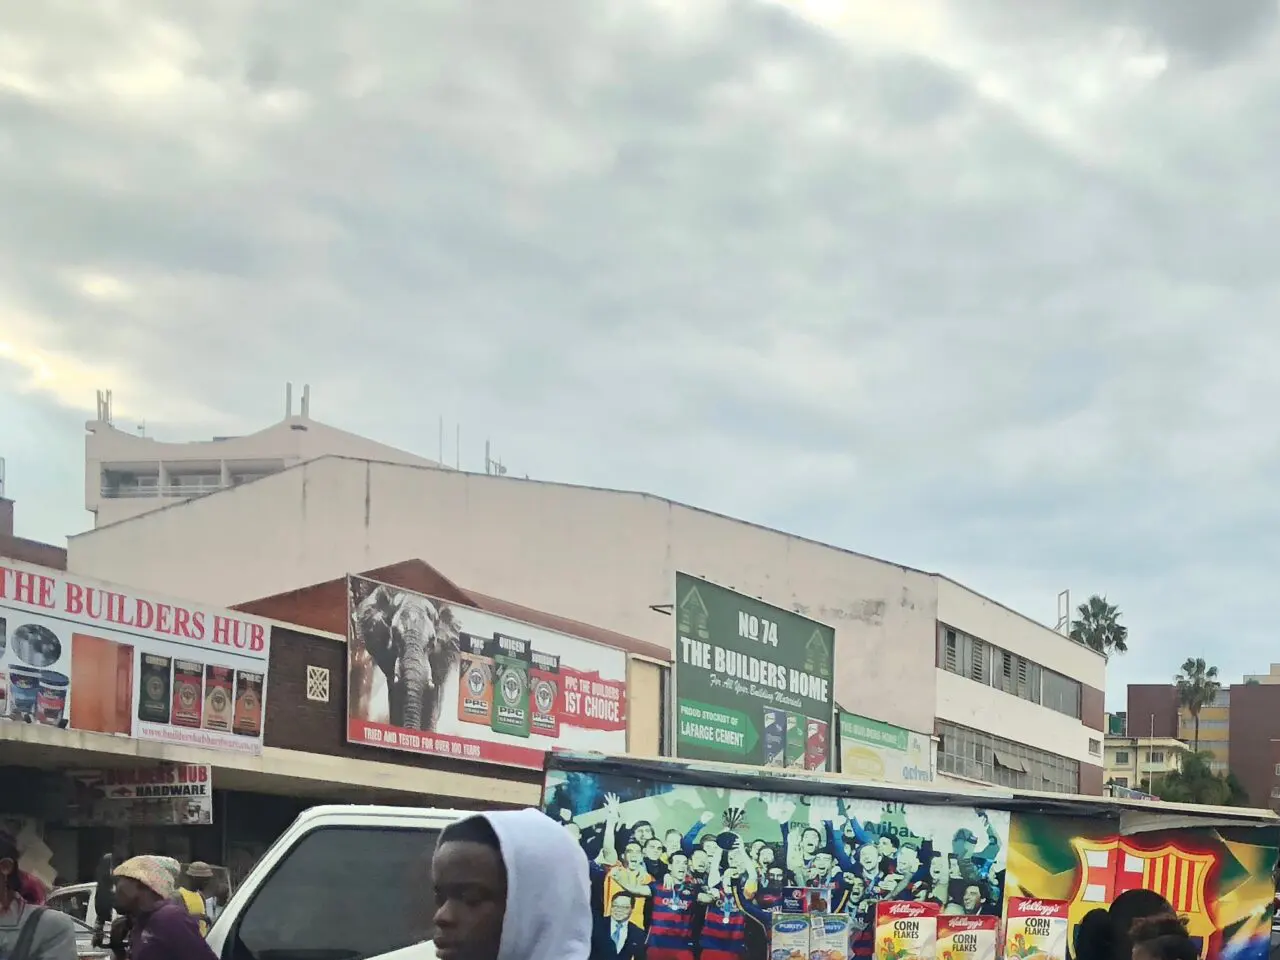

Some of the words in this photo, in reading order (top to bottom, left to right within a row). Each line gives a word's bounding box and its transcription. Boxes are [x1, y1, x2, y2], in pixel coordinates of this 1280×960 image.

[0, 567, 56, 609] THE
[64, 582, 205, 640] BUILDERS
[212, 615, 265, 652] HUB
[761, 619, 778, 648] 74
[680, 636, 711, 670] THE
[714, 646, 787, 691] BUILDERS
[789, 668, 828, 702] HOME
[565, 675, 578, 691] PPC
[580, 679, 590, 691] THE
[465, 698, 487, 708] PPC
[564, 690, 581, 715] 1ST
[585, 695, 620, 722] CHOICE
[500, 706, 523, 717] PPC
[680, 705, 701, 719] PROUD
[384, 730, 397, 743] AND
[399, 732, 420, 748] TESTED
[681, 720, 714, 744] LAFARGE
[715, 727, 745, 747] CEMENT
[178, 765, 207, 783] HUB
[136, 784, 206, 797] HARDWARE
[889, 904, 926, 917] Kellogg's
[1018, 899, 1061, 916] Kellogg's
[894, 920, 919, 931] CORN
[949, 917, 984, 929] Kellogg's
[1025, 917, 1051, 928] CORN
[894, 931, 919, 939] FLAKES
[1025, 927, 1051, 937] FLAKES
[952, 934, 977, 944] CORN
[952, 943, 977, 952] FLAKES
